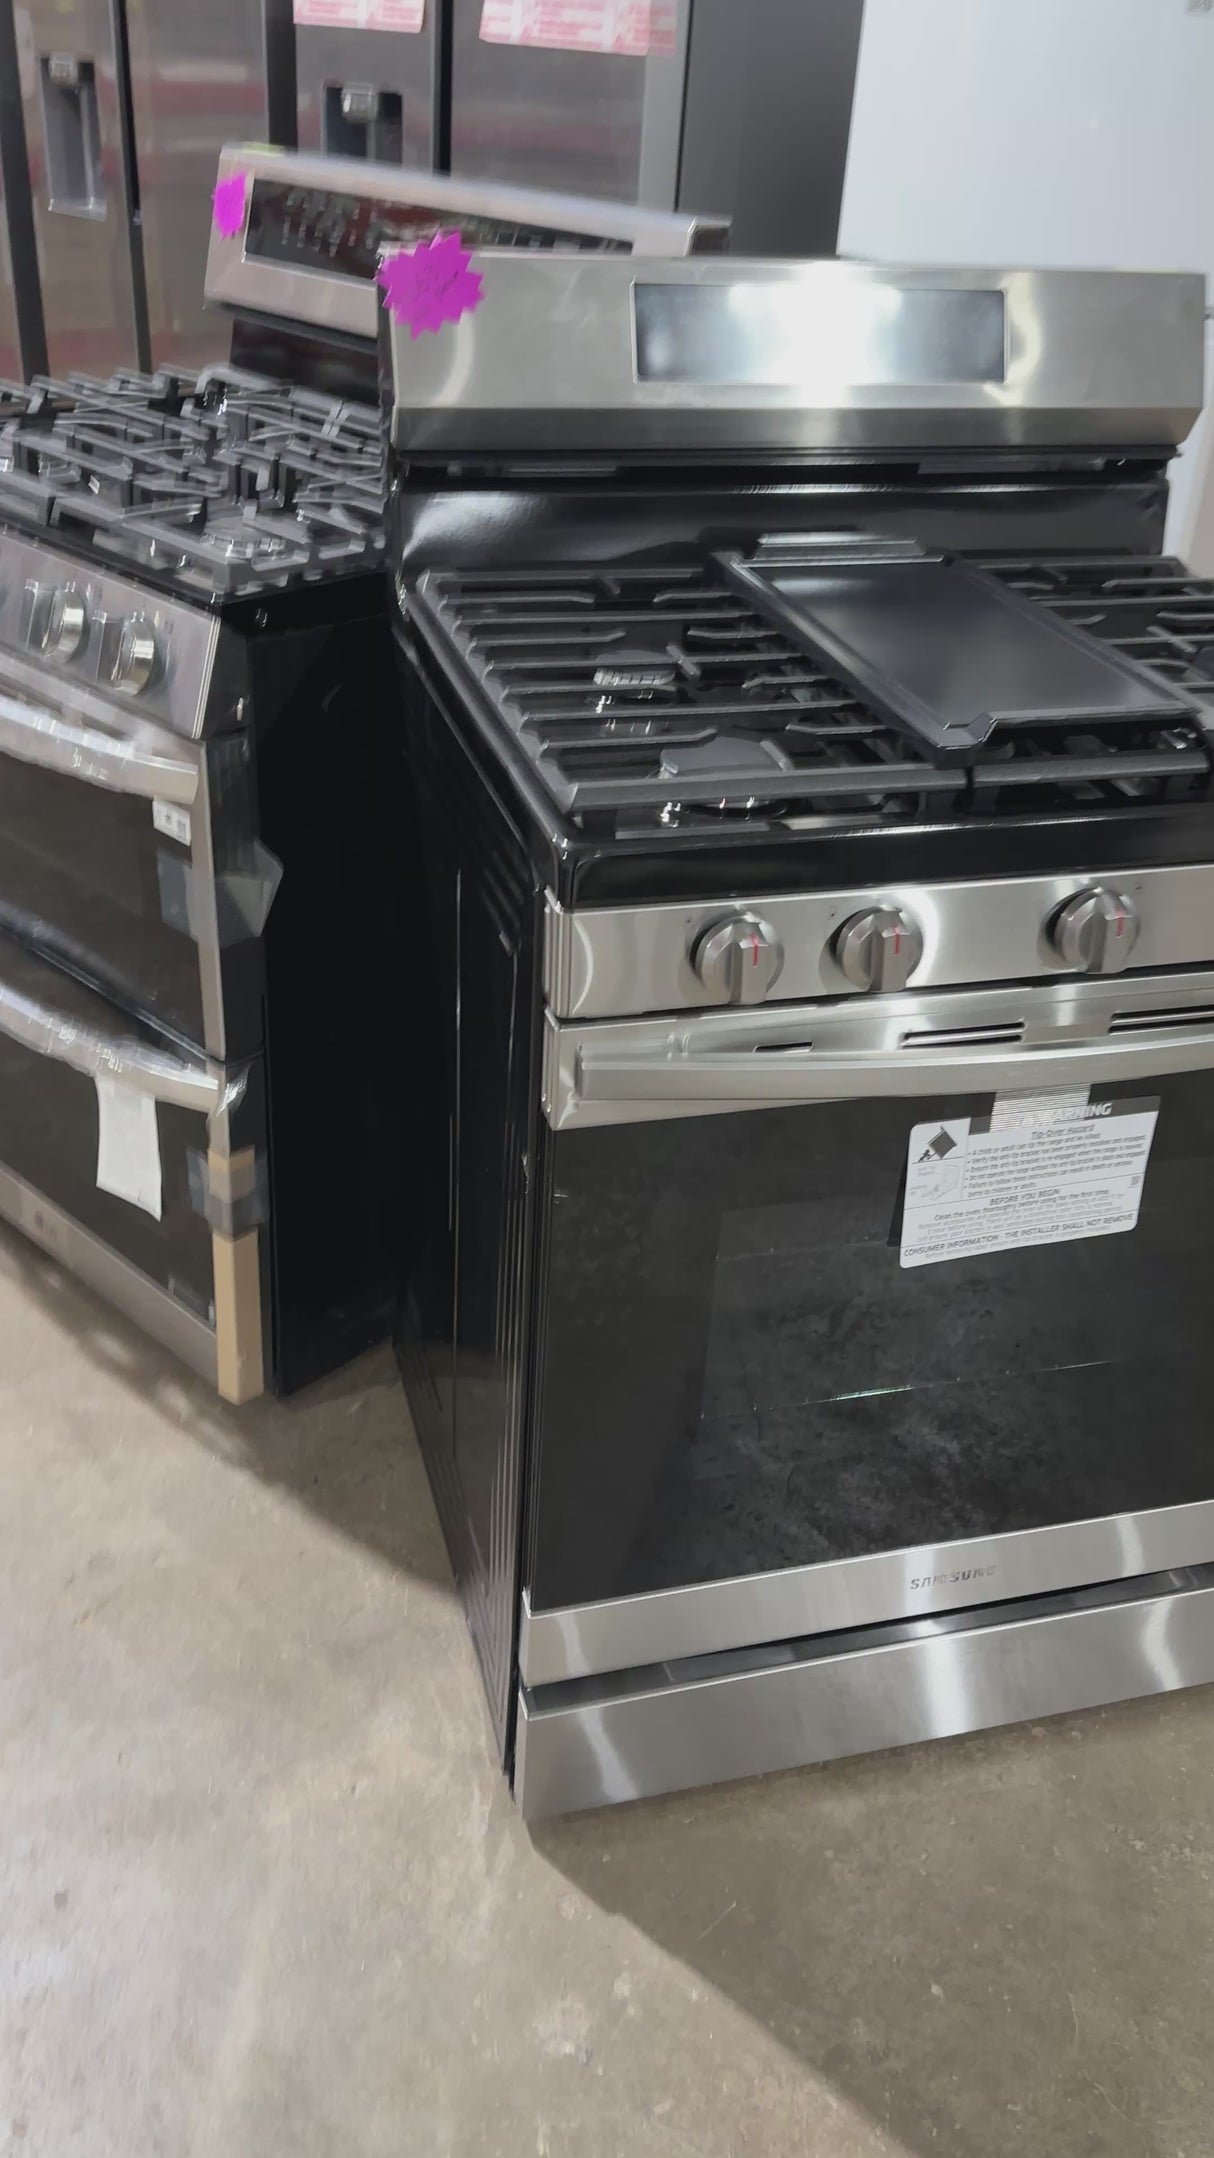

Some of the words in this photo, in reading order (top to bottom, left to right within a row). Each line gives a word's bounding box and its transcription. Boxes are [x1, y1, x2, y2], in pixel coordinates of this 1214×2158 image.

[989, 1194, 1019, 1205] BEFORE
[1020, 1192, 1035, 1201] YOU
[1037, 1189, 1060, 1198] BEGIN
[904, 1243, 946, 1256] CONSUMER
[1005, 1230, 1020, 1239] THE
[1020, 1224, 1059, 1237] INSTALLER
[1061, 1220, 1085, 1231] SHALL
[1086, 1218, 1102, 1227] NOT
[1103, 1213, 1134, 1224] REMOVE
